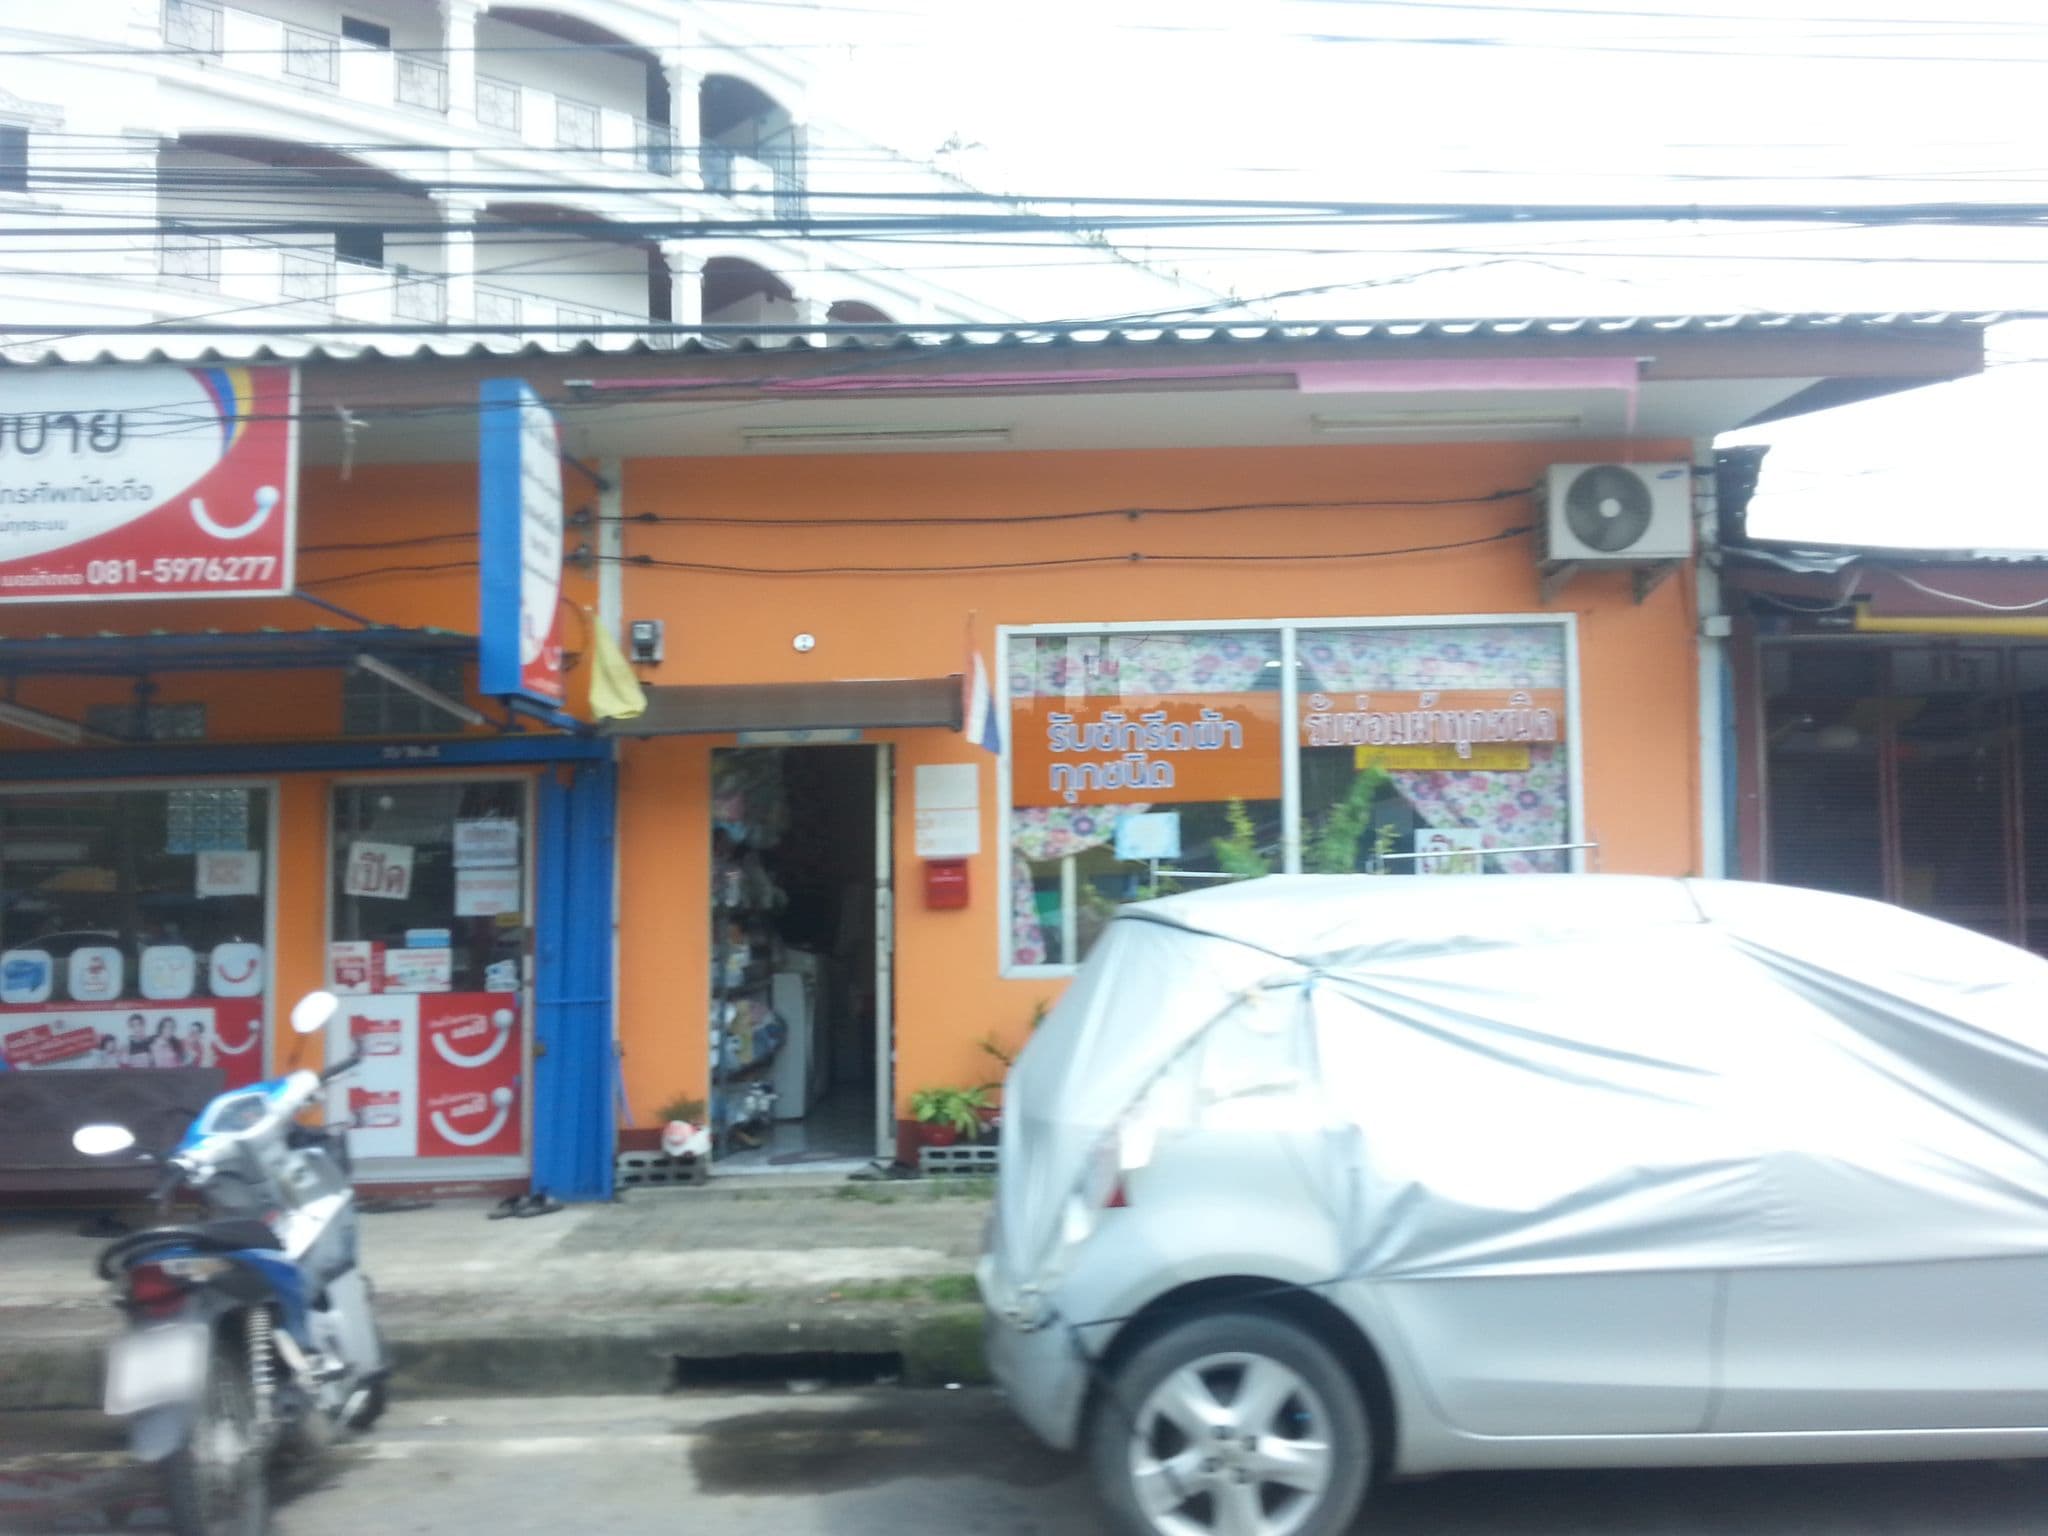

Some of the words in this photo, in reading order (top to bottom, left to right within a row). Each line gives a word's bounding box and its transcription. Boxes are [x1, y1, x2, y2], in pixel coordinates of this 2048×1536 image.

[86, 555, 277, 585] 081-5976277
[1049, 752, 1175, 803] ทุกชนิด
